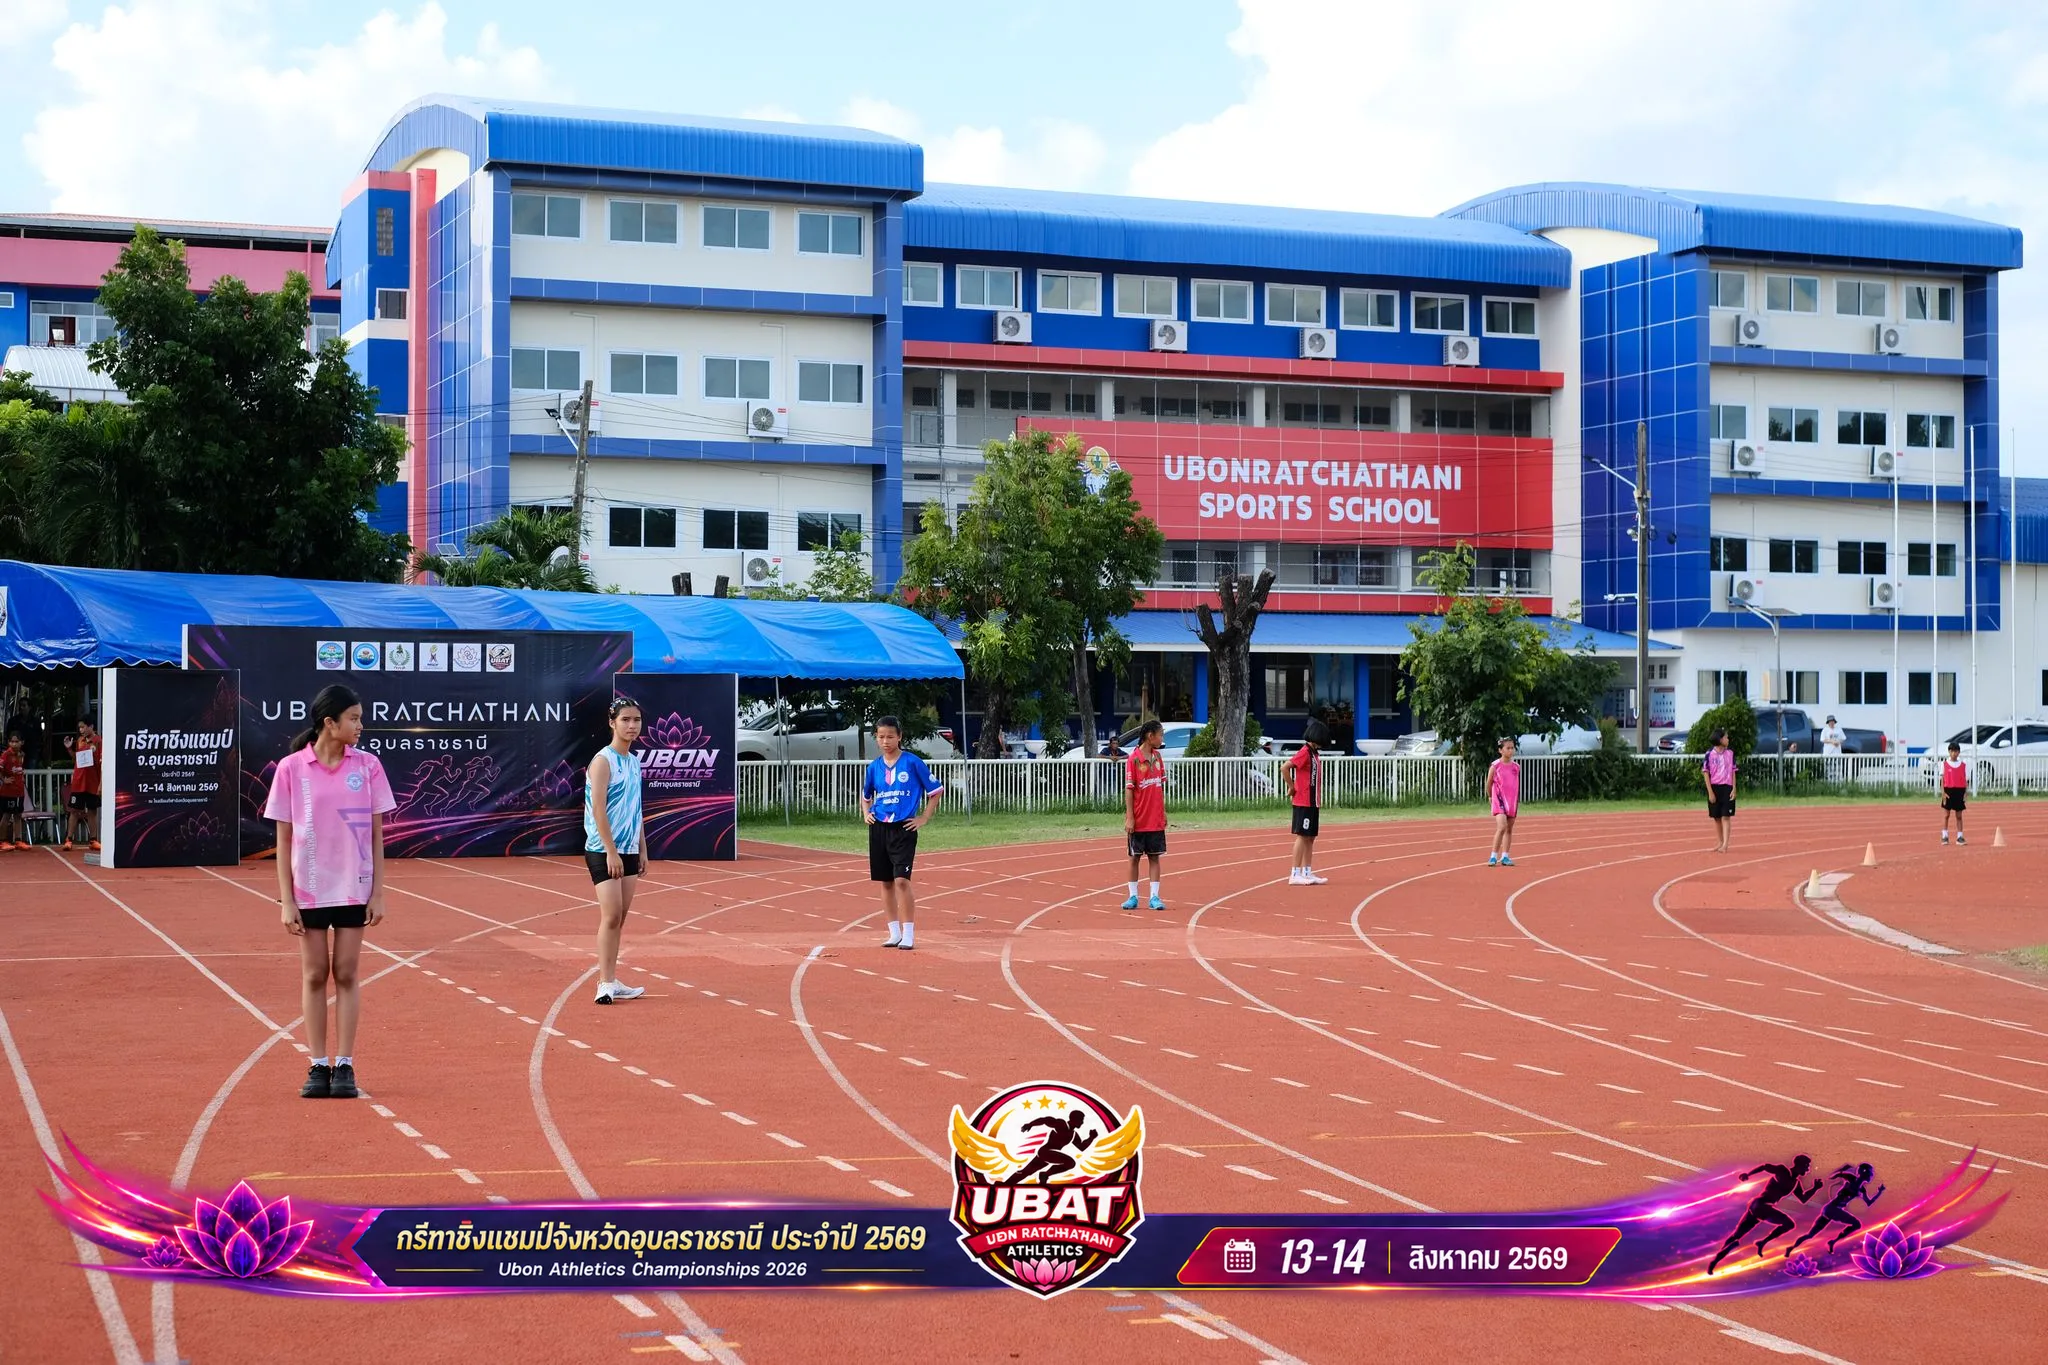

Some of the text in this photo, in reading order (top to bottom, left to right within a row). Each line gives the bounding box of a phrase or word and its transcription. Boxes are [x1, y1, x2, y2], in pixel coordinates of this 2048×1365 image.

[1164, 455, 1461, 490] UBONRATCHATHANI
[1199, 492, 1440, 524] SPORTS SCHOOL
[372, 701, 570, 722] RATCHATHANI
[137, 751, 218, 770] จ.อุบลราชธานี
[635, 749, 720, 768] UBON
[166, 782, 197, 792] สิงหาคม
[198, 782, 219, 792] 2569
[1302, 818, 1310, 830] 8
